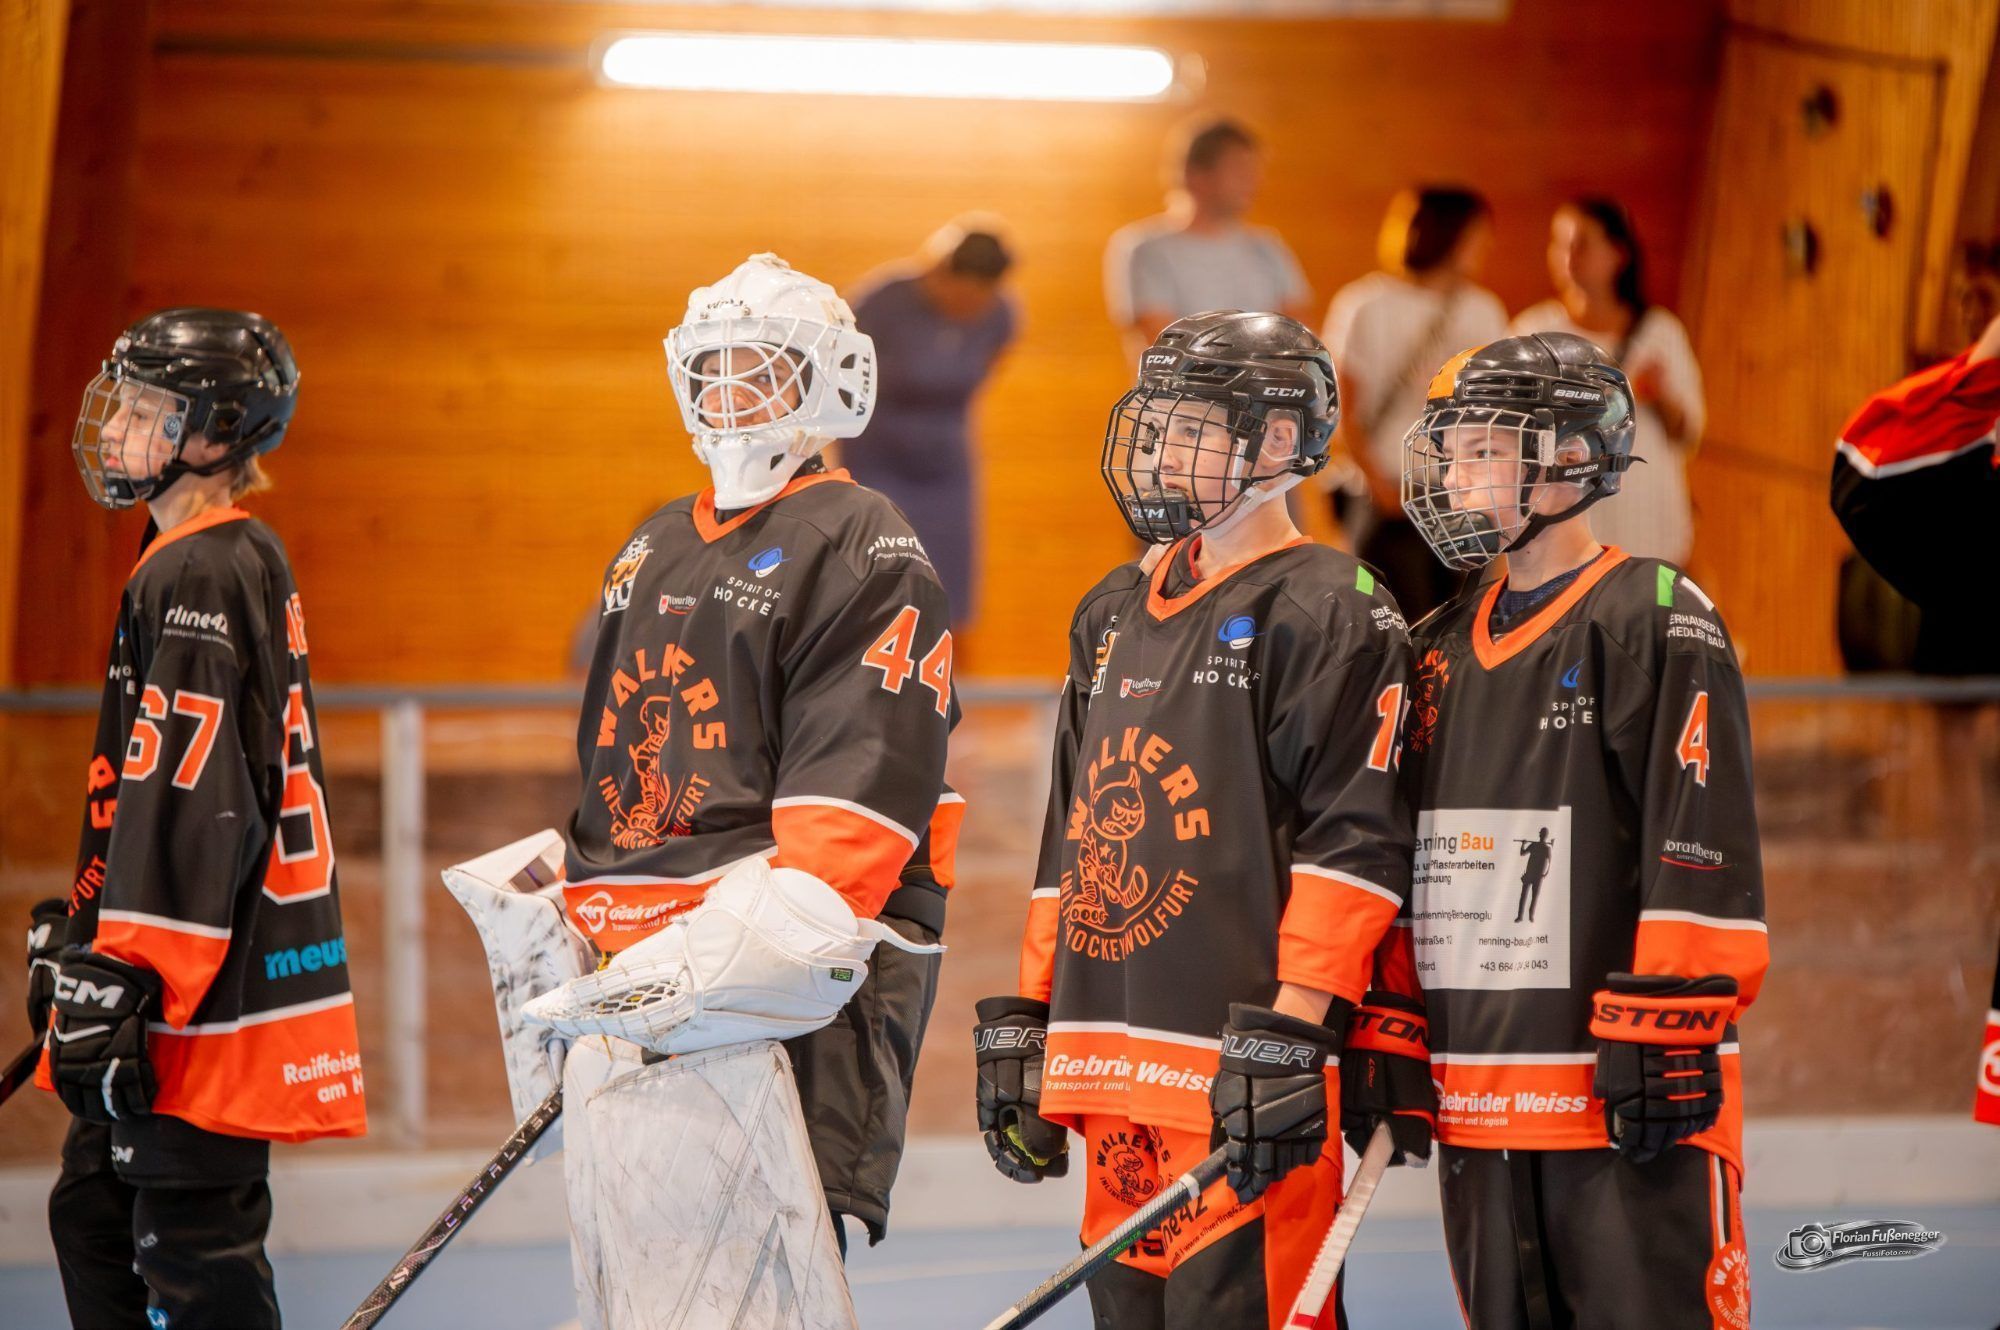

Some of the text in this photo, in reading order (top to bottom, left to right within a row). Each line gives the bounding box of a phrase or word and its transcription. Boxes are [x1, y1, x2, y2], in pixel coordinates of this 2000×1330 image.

[1147, 355, 1176, 365] CCM
[1263, 387, 1306, 398] CCM
[1554, 389, 1601, 402] BAUER
[1564, 464, 1599, 476] BAUER
[726, 576, 782, 600] SPIRIT OF
[1706, 634, 1726, 649] BAU
[861, 605, 952, 719] 44
[1207, 655, 1247, 670] SPIRIT
[1193, 670, 1252, 690] HOCK
[1577, 696, 1595, 706] OF
[121, 683, 225, 791] 67
[1366, 683, 1411, 773] 1
[1675, 691, 1710, 788] 4
[1460, 832, 1494, 851] Bau
[1593, 1003, 1720, 1031] STON
[317, 1082, 347, 1104] am
[1045, 1080, 1100, 1092] Transport
[1514, 1092, 1588, 1113] Weiss
[1096, 1131, 1172, 1167] WALKES
